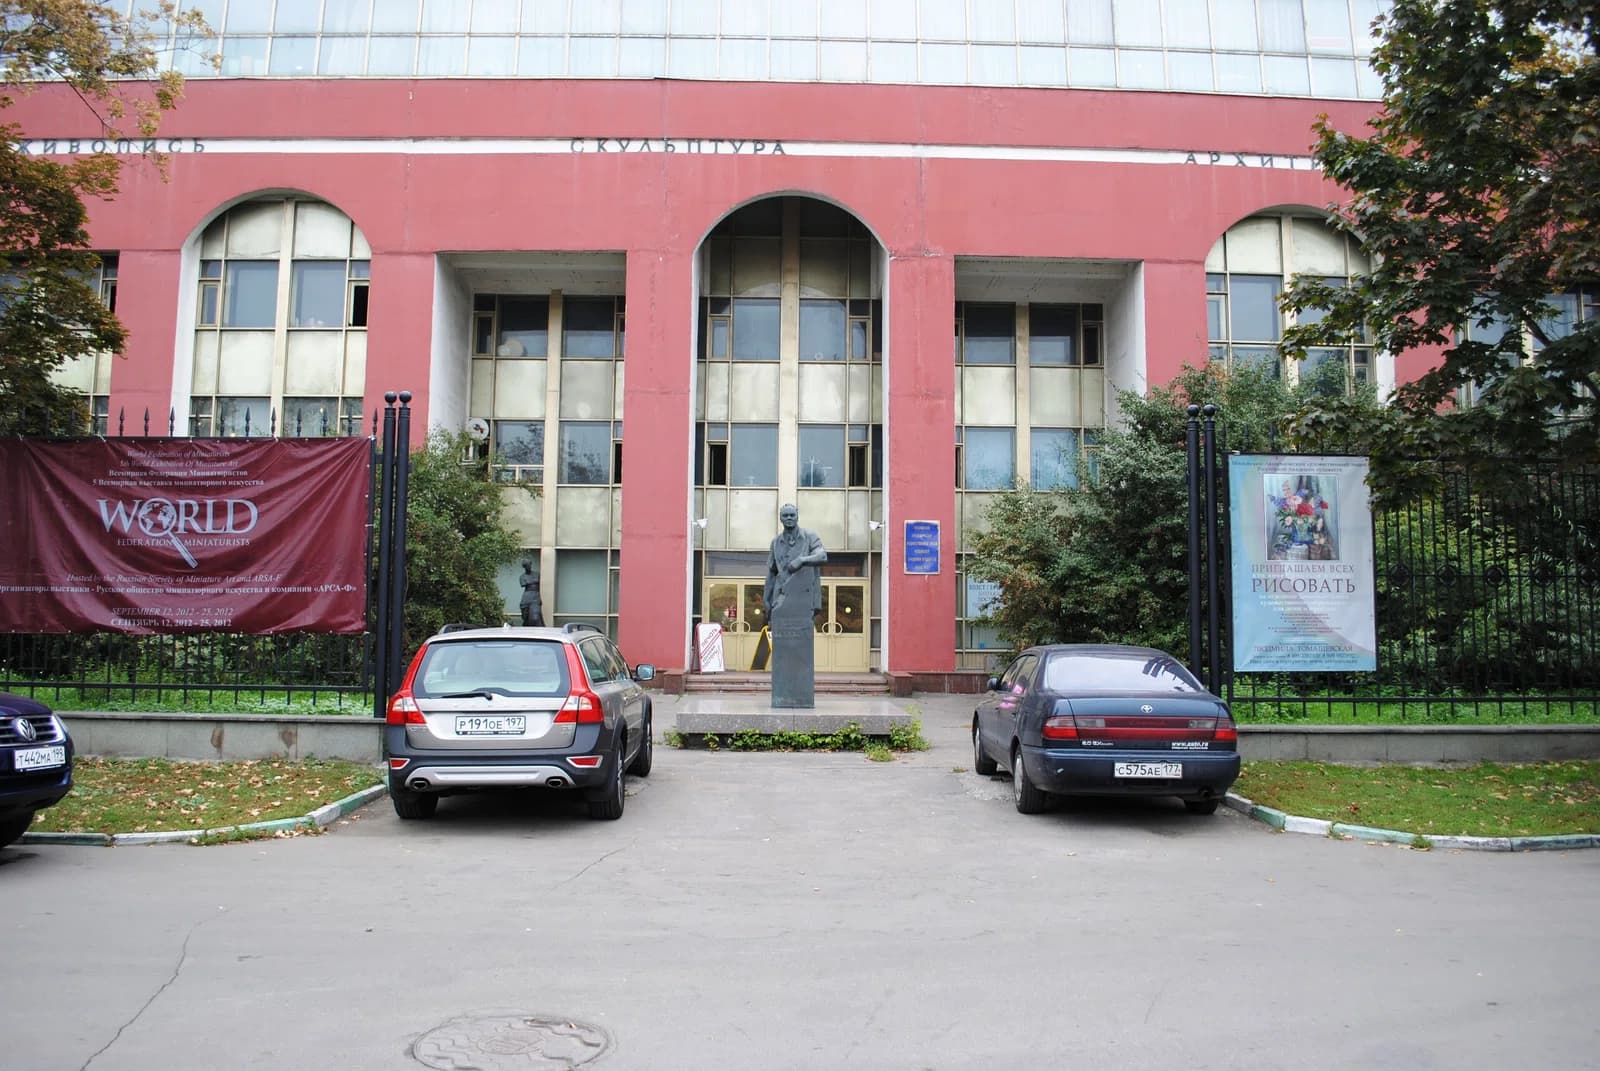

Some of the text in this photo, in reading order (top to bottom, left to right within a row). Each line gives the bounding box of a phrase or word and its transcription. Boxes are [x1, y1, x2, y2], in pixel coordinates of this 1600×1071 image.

[570, 138, 786, 155] СКУЛЬПТУРА
[96, 498, 258, 536] WORLD
[184, 538, 250, 546] MINIATURISTS
[1330, 564, 1354, 573] ВСЕХ
[1251, 578, 1356, 593] РИСОВАТЬ
[111, 607, 160, 616] SEPTEMBER
